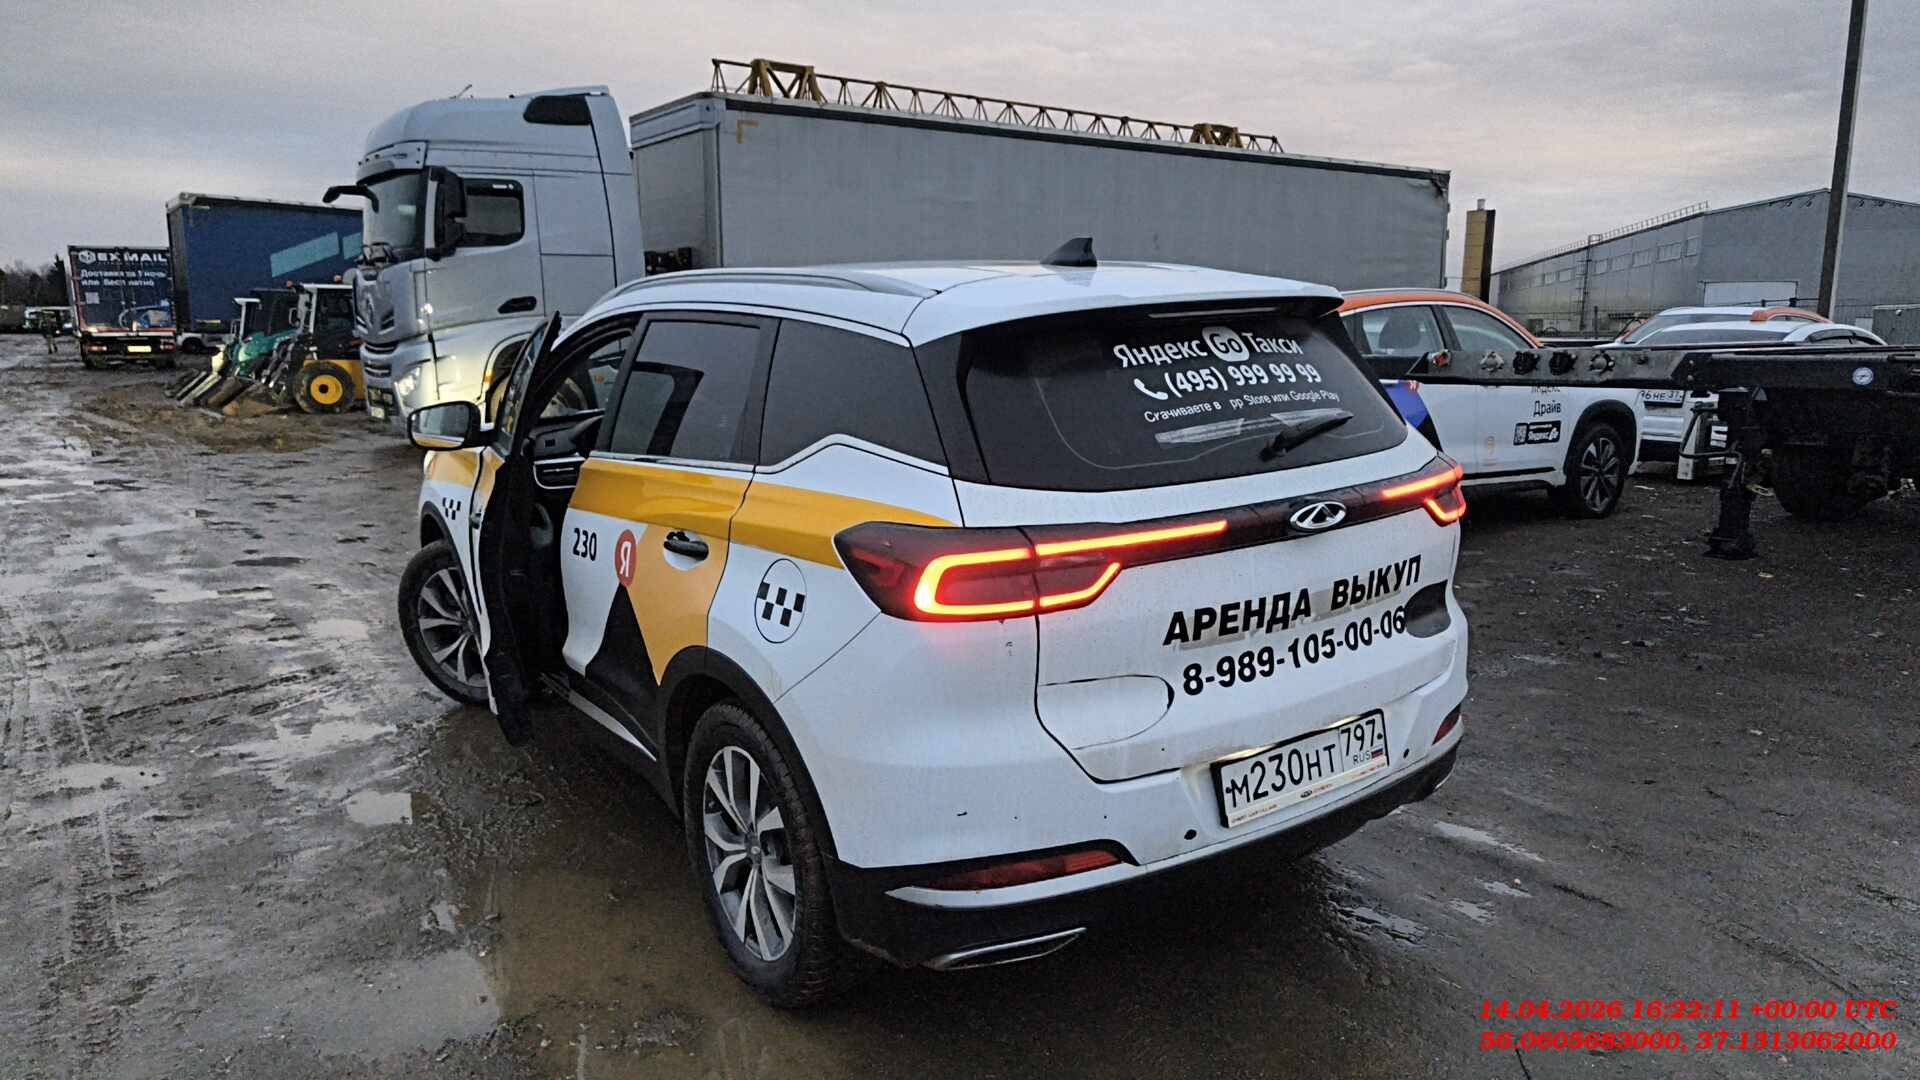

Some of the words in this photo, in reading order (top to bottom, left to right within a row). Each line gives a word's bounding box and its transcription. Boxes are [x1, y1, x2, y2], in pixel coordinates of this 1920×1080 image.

[1113, 339, 1208, 368] Яндекс
[1207, 331, 1246, 356] Go
[1241, 332, 1304, 355] Такси
[1164, 366, 1228, 398] (495)
[1227, 363, 1269, 386] 999
[1268, 363, 1297, 383] 99
[1295, 363, 1322, 383] 99
[1212, 400, 1222, 410] в
[1271, 393, 1291, 403] или
[1289, 390, 1321, 403] Google
[1319, 389, 1340, 403] Play
[1533, 400, 1561, 417] Драйв
[573, 527, 597, 561] 230
[619, 540, 632, 578] Я
[1162, 588, 1311, 646] АРЕНДА
[1330, 554, 1421, 611] ВЫКУП
[1183, 605, 1406, 696] 8-989-105-00-06
[1340, 718, 1376, 757] 797
[1353, 751, 1371, 766] RUS
